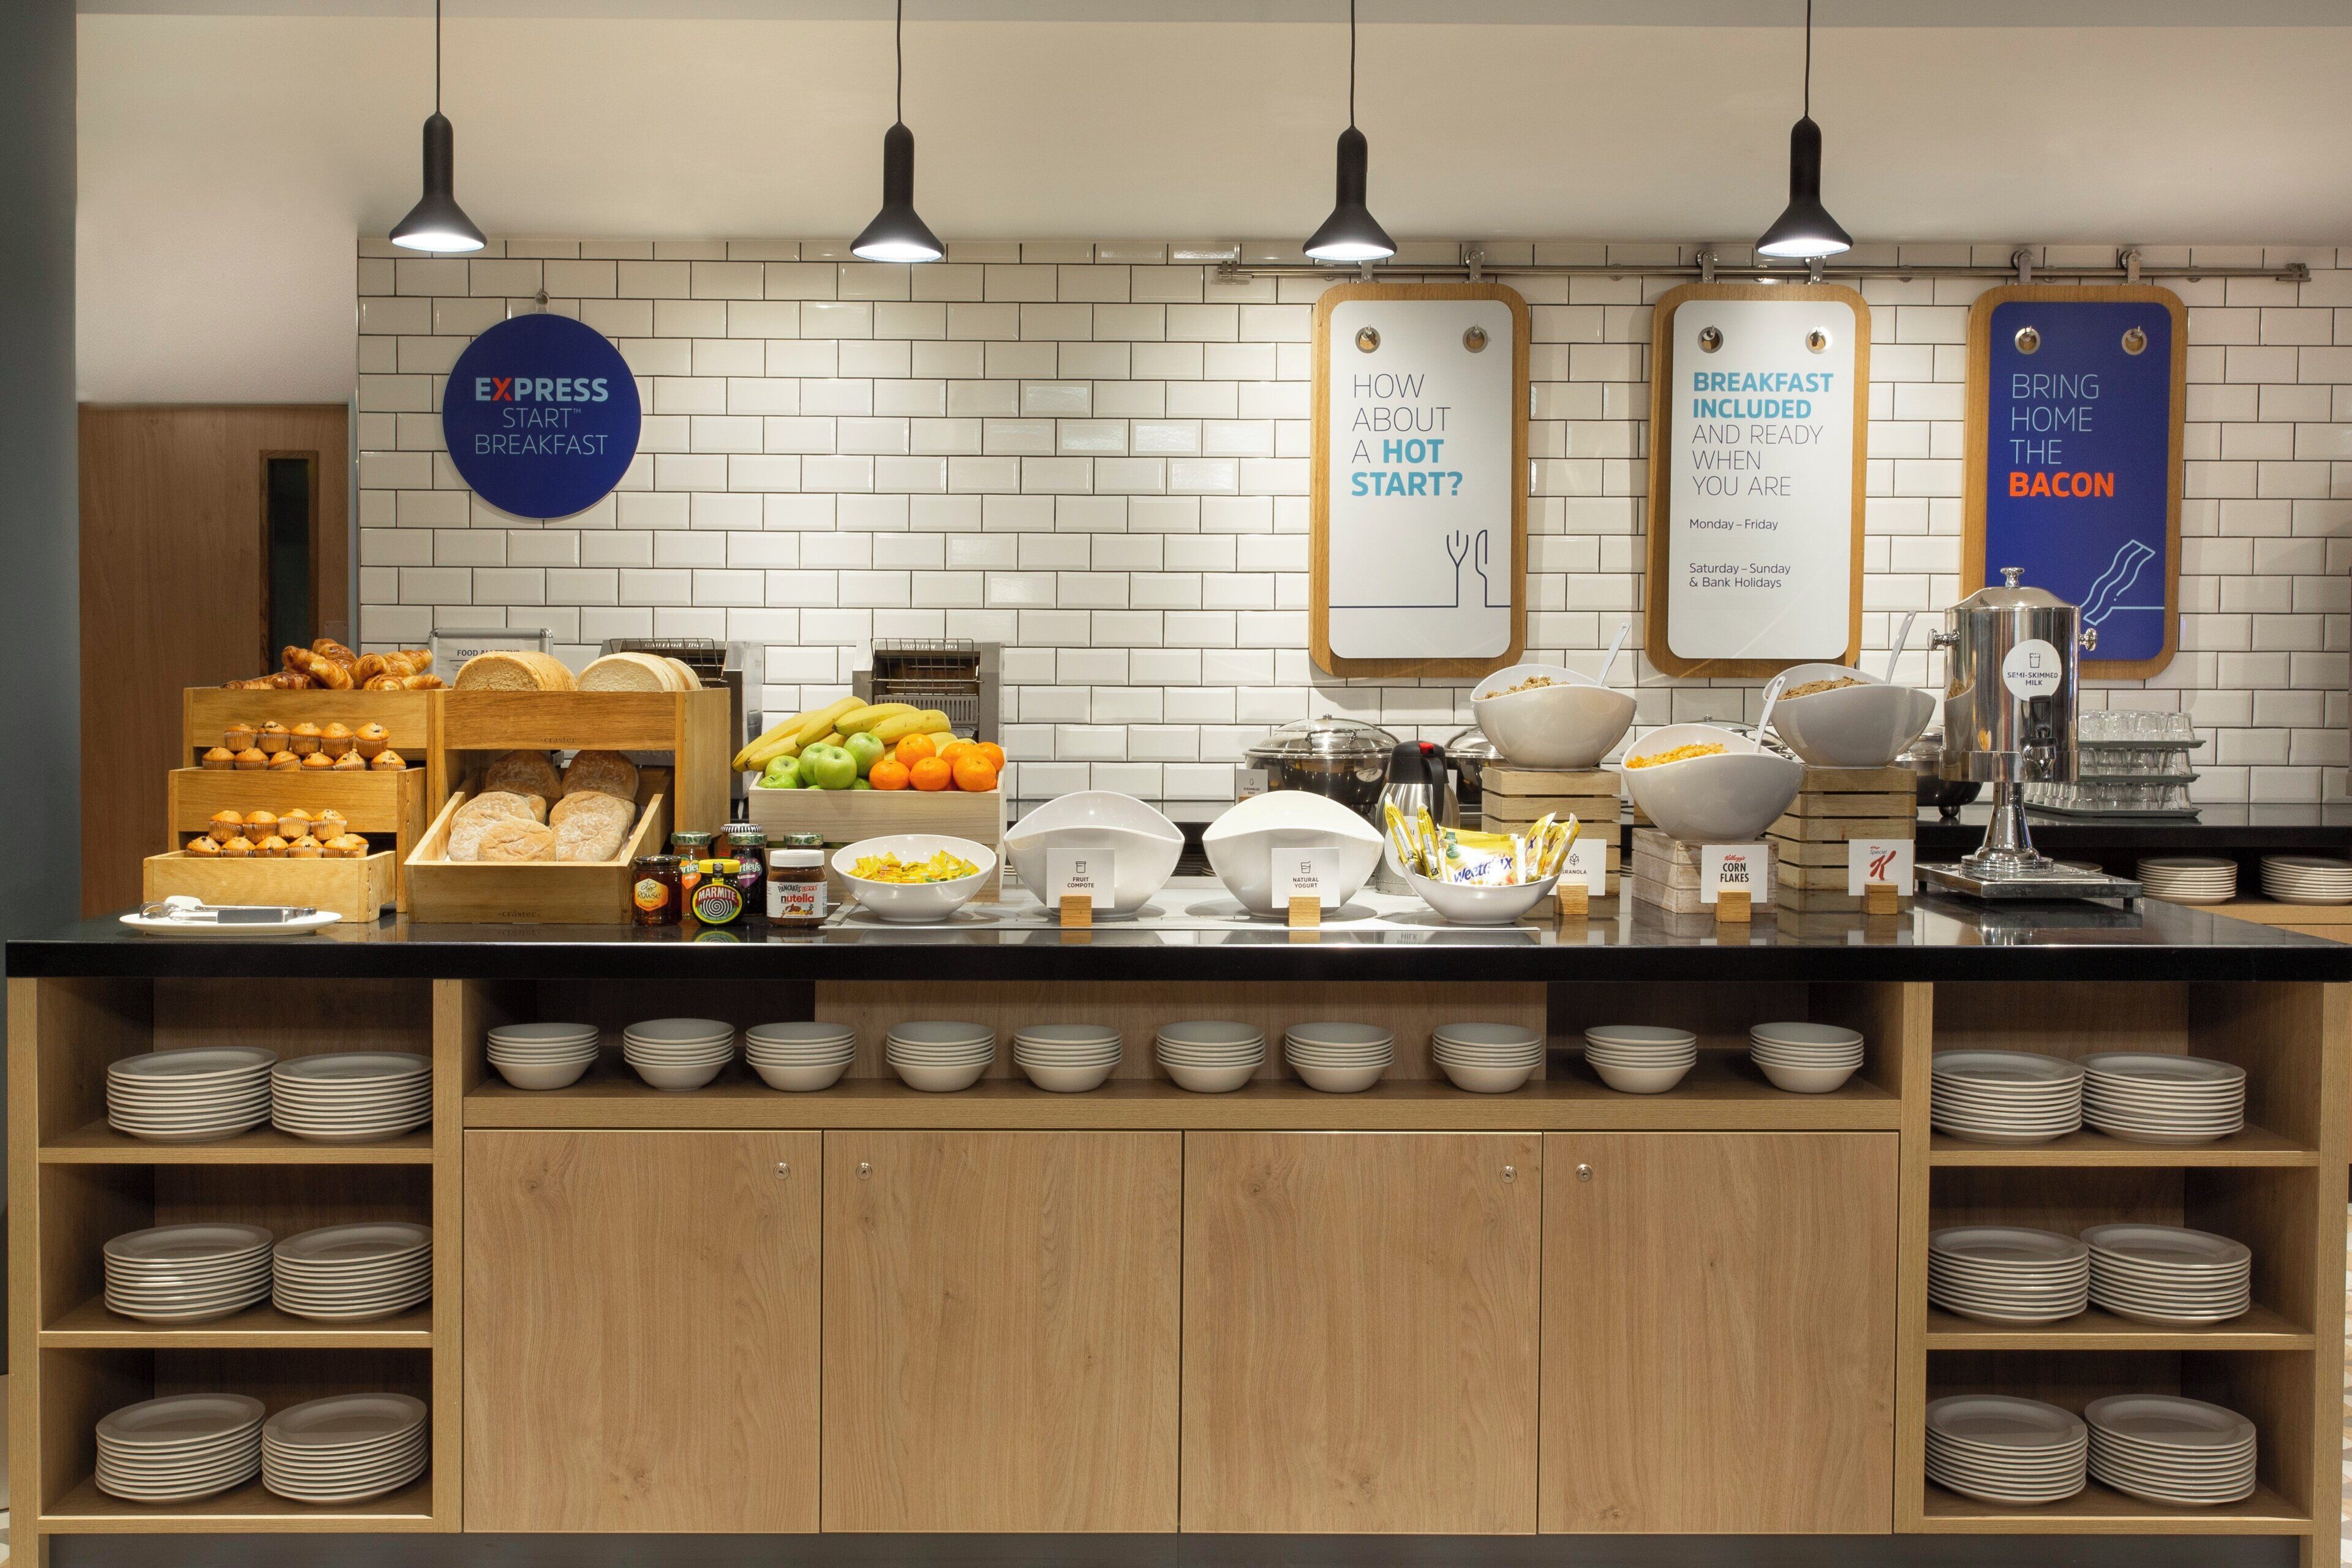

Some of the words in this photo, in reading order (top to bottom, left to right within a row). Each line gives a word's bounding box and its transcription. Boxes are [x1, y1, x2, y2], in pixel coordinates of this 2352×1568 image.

[476, 377, 608, 402] EXPRESS
[1354, 374, 1425, 399] HOW
[1694, 372, 1834, 393] BREAKFAST
[2012, 374, 2098, 399] BRING
[1693, 398, 1812, 419] INCLUDED
[2011, 406, 2092, 432] HOME
[1352, 407, 1452, 432] ABOUT
[475, 434, 608, 455] BREAKFAST
[1692, 424, 1740, 444] AND
[1751, 424, 1823, 445] READY
[1351, 439, 1371, 464] A
[1383, 439, 1444, 464] HOT
[1692, 450, 1760, 470] WHEN
[2009, 439, 2062, 464] THE
[1351, 472, 1463, 497] START?
[1692, 475, 1738, 496] YOU
[1747, 476, 1791, 496] ARE
[2010, 472, 2114, 497] BACON
[1689, 518, 1734, 530] Monday
[1744, 519, 1778, 531] Friday
[1689, 562, 1740, 575] Saturday
[1749, 563, 1791, 575] Sunday
[1689, 577, 1698, 587] &
[1702, 577, 1730, 587] Bank
[1735, 577, 1782, 589] Holidays
[1722, 862, 1746, 872] CORN
[1724, 854, 1746, 862] Kellogg's
[1869, 850, 1897, 881] K
[778, 884, 802, 893] PANCAKES
[1720, 873, 1749, 883] FLAKES
[698, 887, 737, 901] MARMITE
[781, 894, 815, 903] nutella
